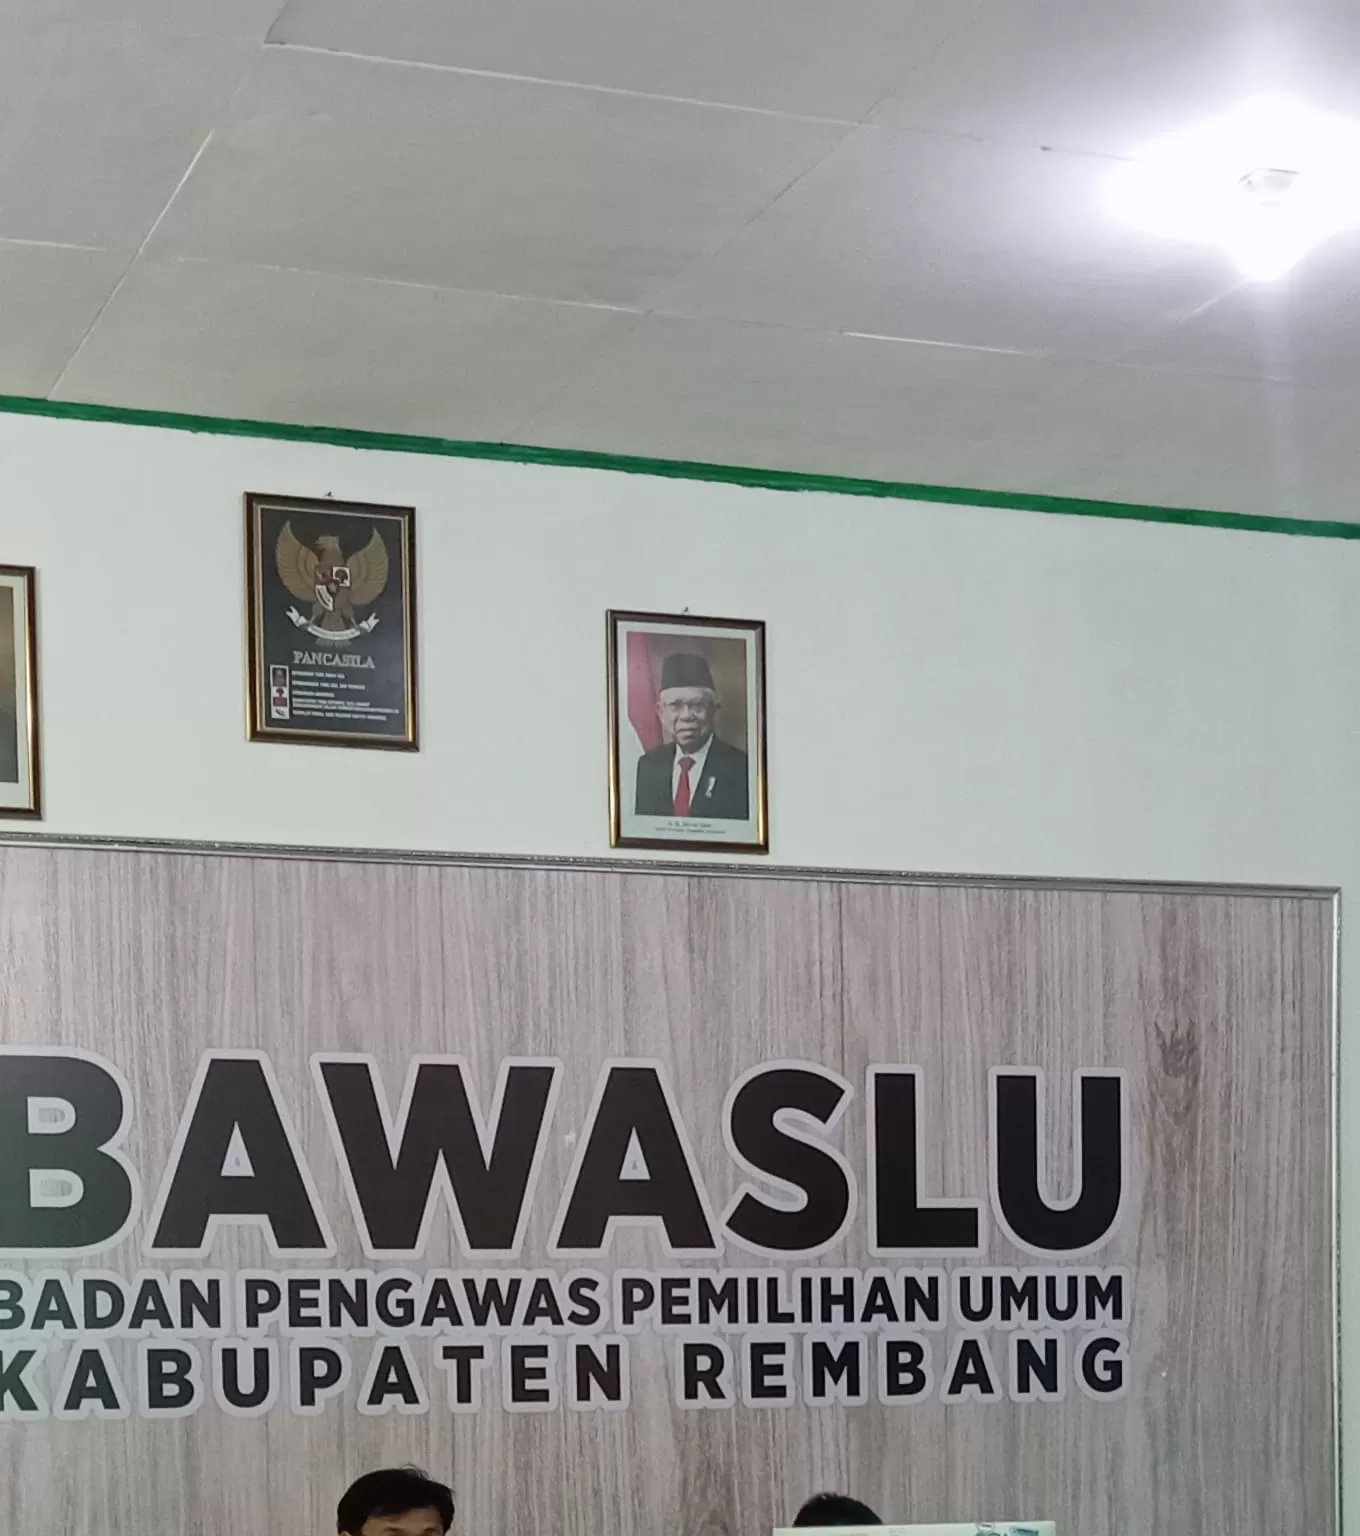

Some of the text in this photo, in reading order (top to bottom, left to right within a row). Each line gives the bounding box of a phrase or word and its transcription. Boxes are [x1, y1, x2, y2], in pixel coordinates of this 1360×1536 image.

[292, 650, 376, 669] PANCASILA
[246, 1278, 601, 1328] PENGAWAS
[622, 1277, 938, 1325] PEMILIHAN
[960, 1275, 1122, 1321] UMUM
[684, 1338, 1122, 1400] REMBANG
